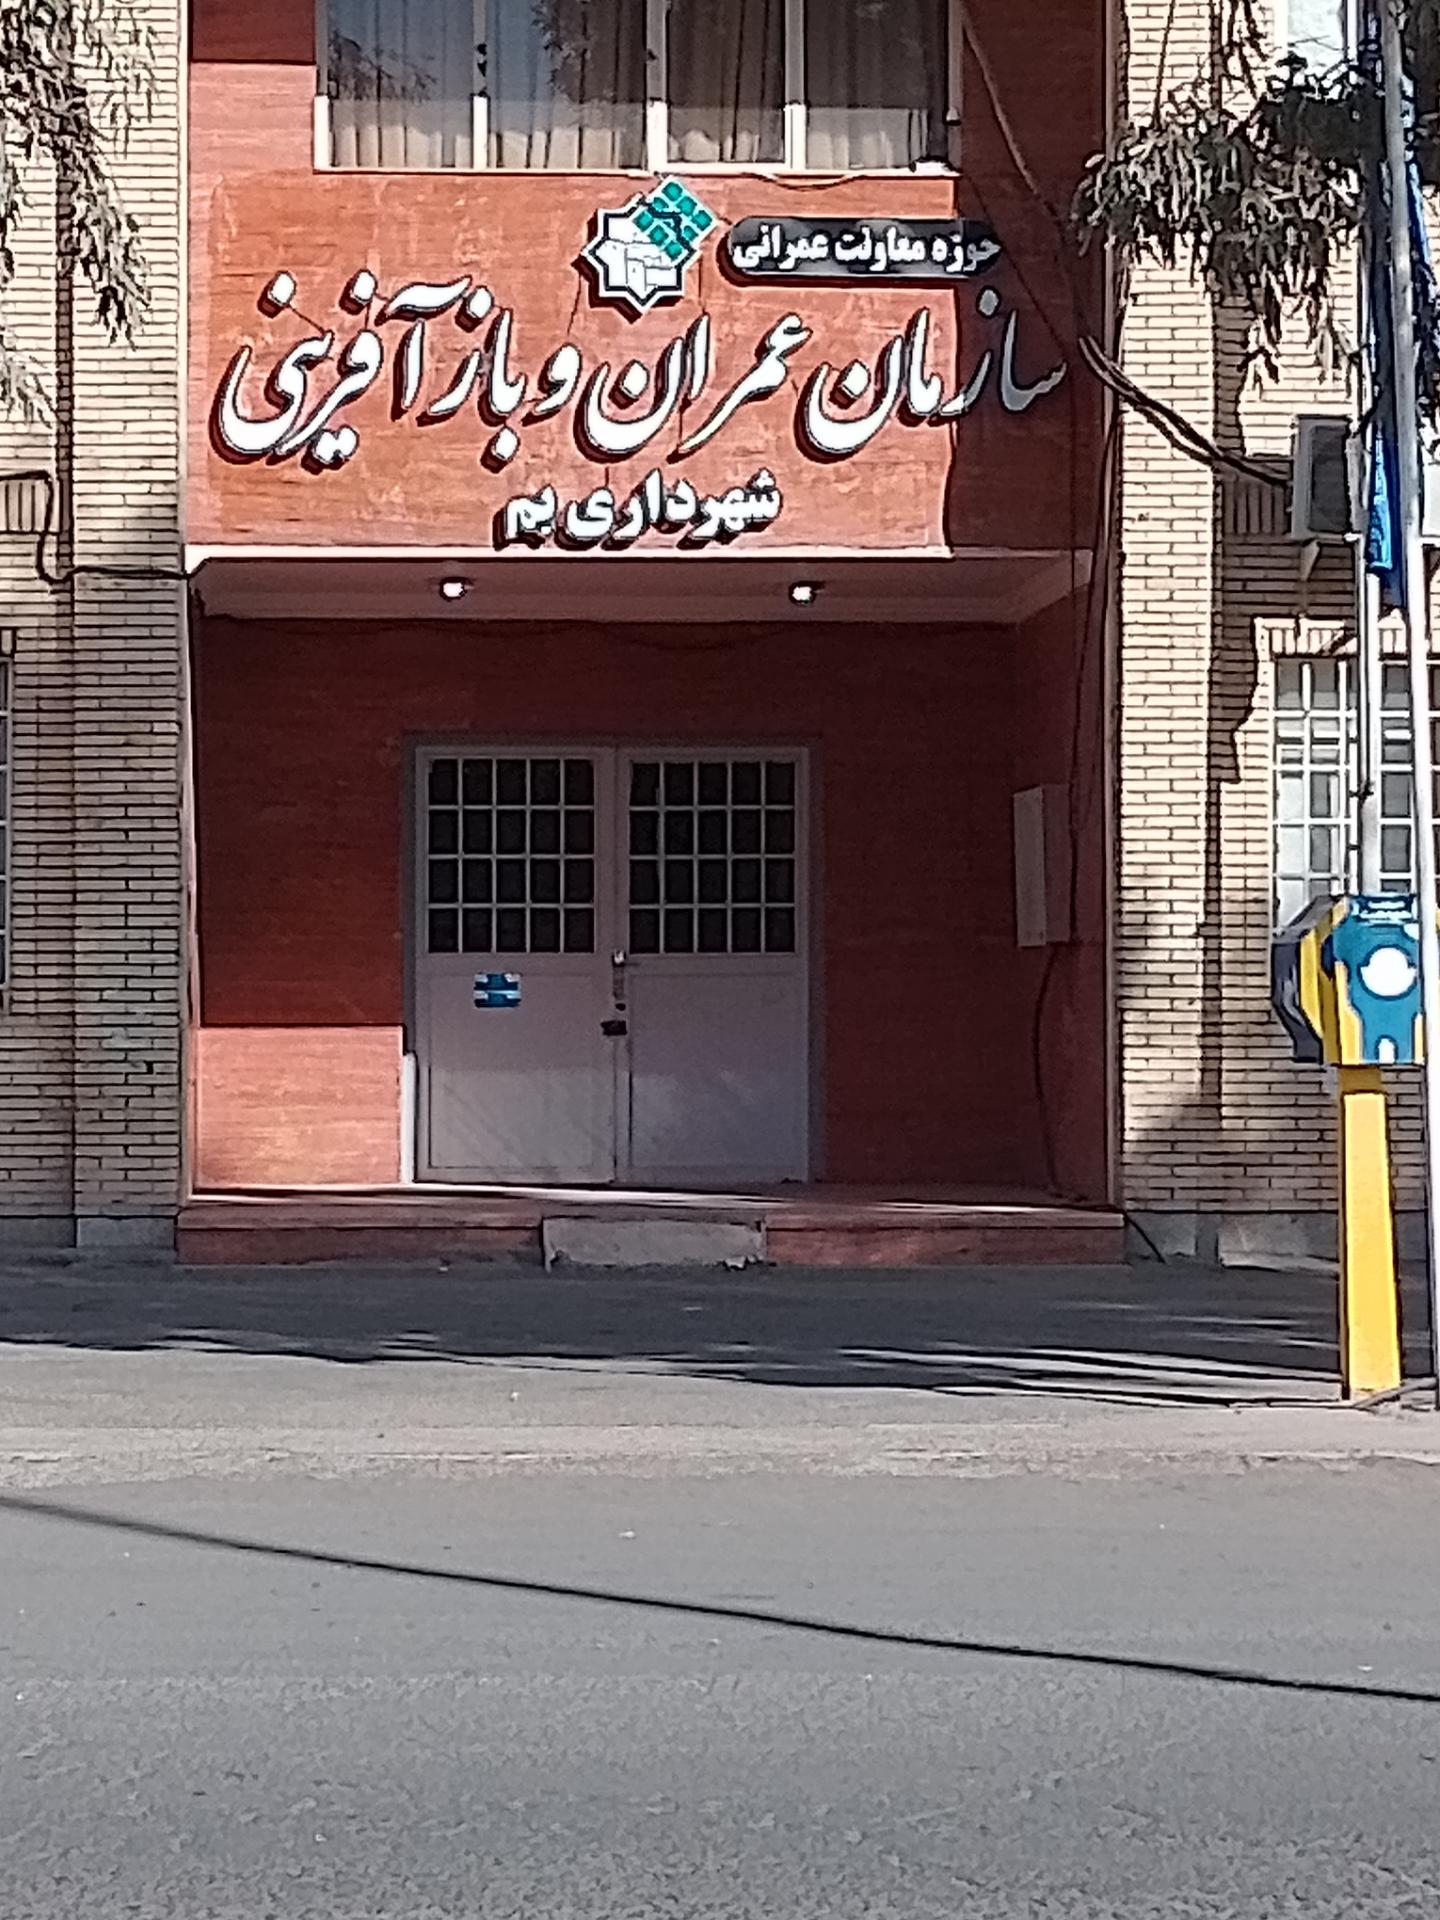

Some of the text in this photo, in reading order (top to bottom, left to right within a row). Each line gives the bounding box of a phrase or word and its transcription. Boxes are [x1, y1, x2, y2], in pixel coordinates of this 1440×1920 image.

[732, 224, 829, 270] عمرانی
[931, 232, 1001, 273] حوزه
[535, 343, 583, 414] و
[584, 312, 813, 454] عمران
[803, 288, 1067, 453] سازمان
[505, 468, 783, 539] شهرداری بم
